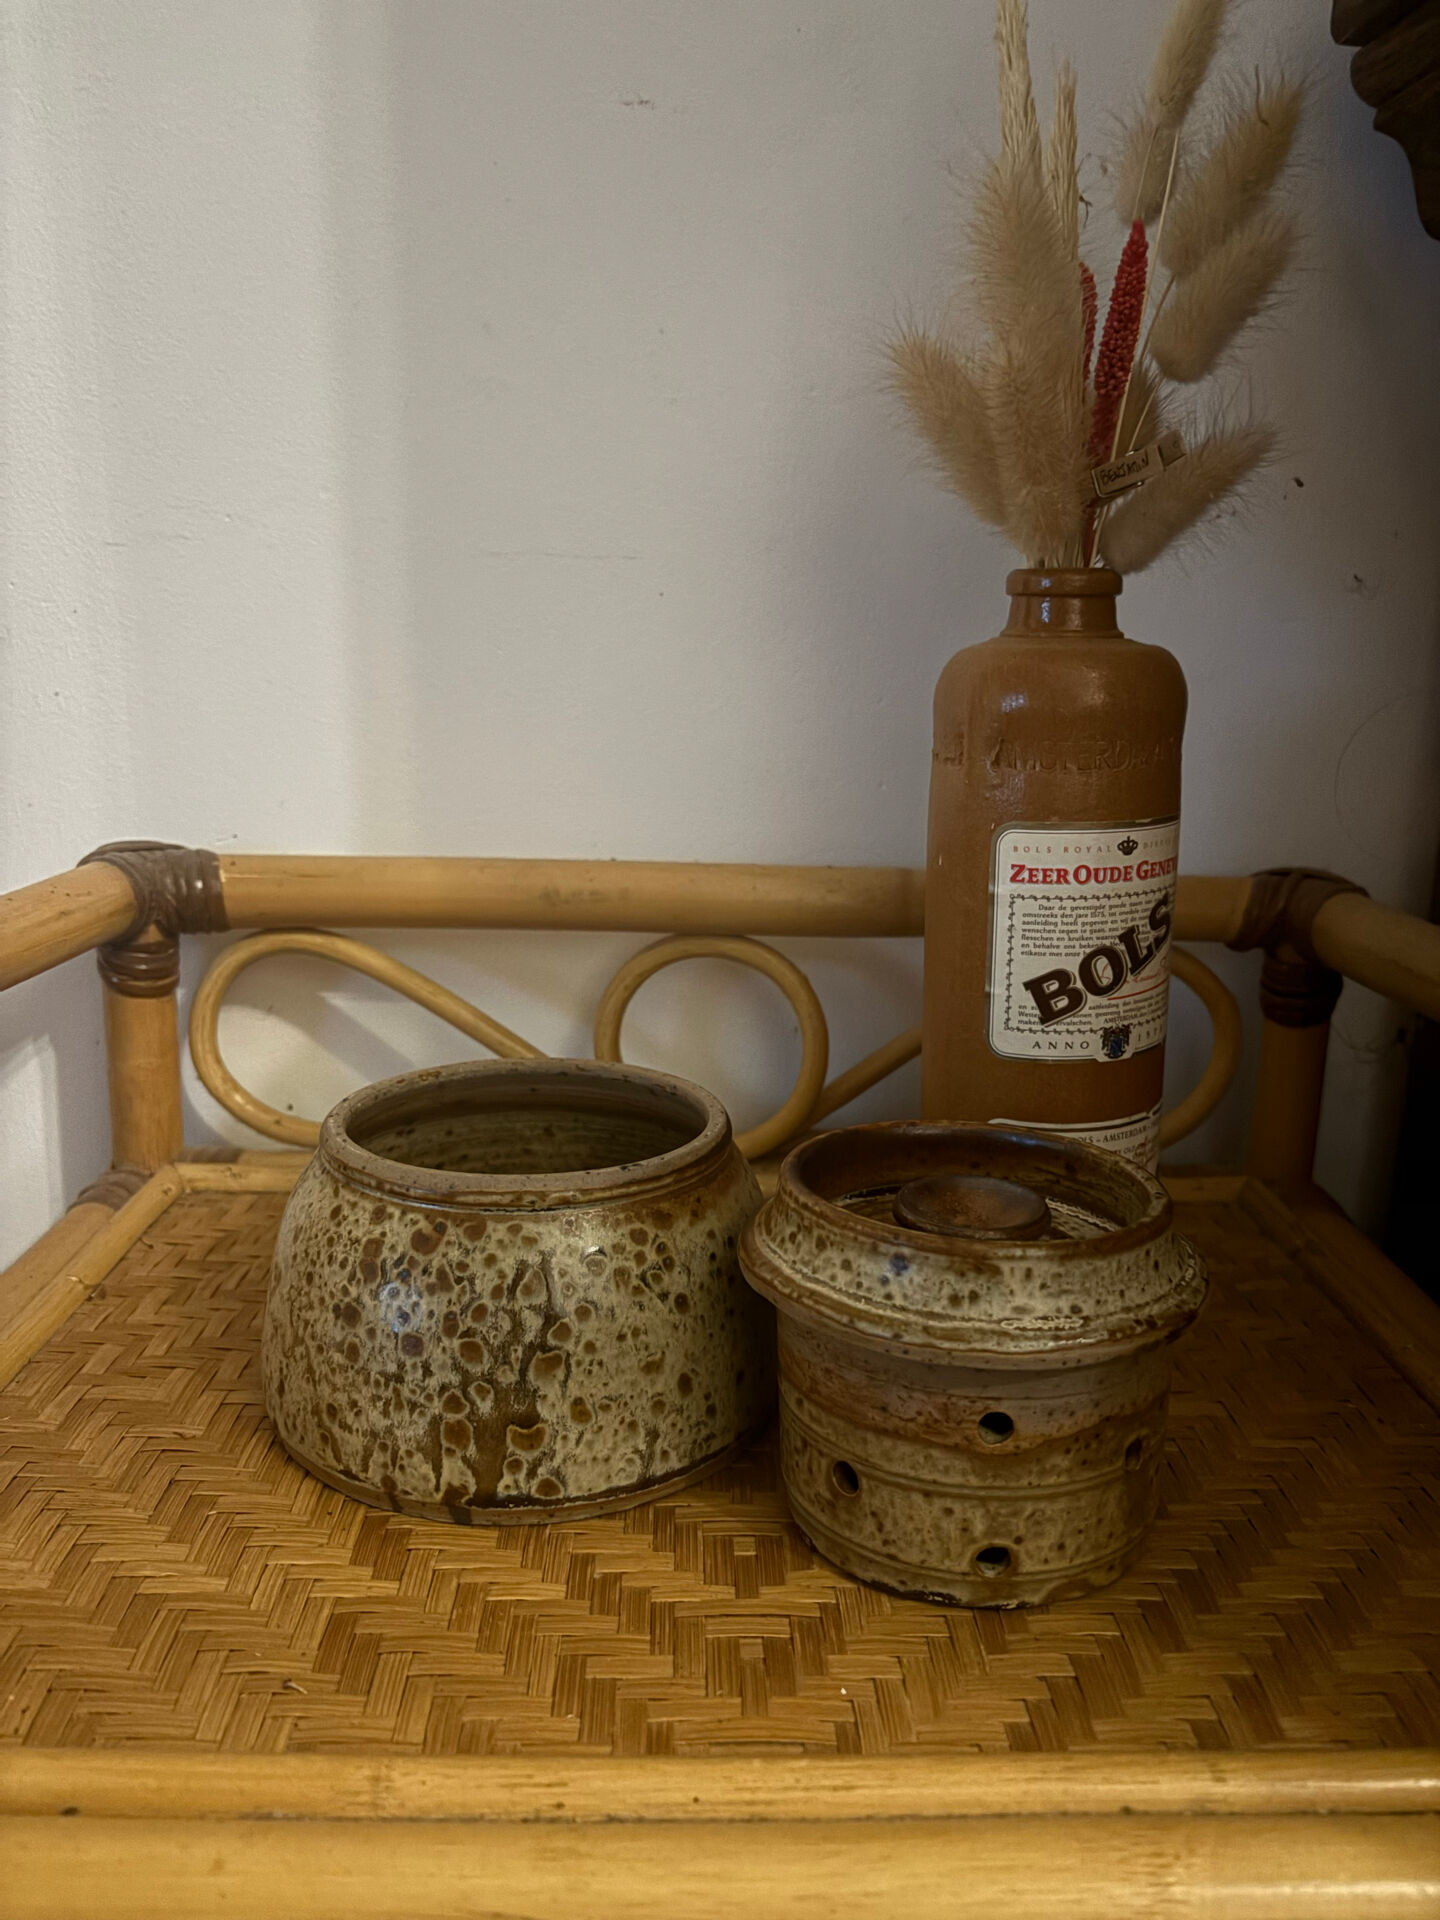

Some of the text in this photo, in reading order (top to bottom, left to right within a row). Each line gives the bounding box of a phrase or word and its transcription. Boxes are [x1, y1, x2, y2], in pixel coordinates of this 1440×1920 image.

[1013, 845, 1052, 854] BOLS
[1063, 844, 1112, 854] ROYAL
[1009, 863, 1071, 885] ZEER
[1072, 864, 1133, 885] OUDE
[1070, 903, 1106, 912] gevestigde
[1074, 913, 1089, 921] jare
[1021, 919, 1058, 928] aanleiding
[1081, 919, 1109, 928] gegeven
[1022, 892, 1171, 1028] BOLS
[1032, 1041, 1090, 1050] ANNO
